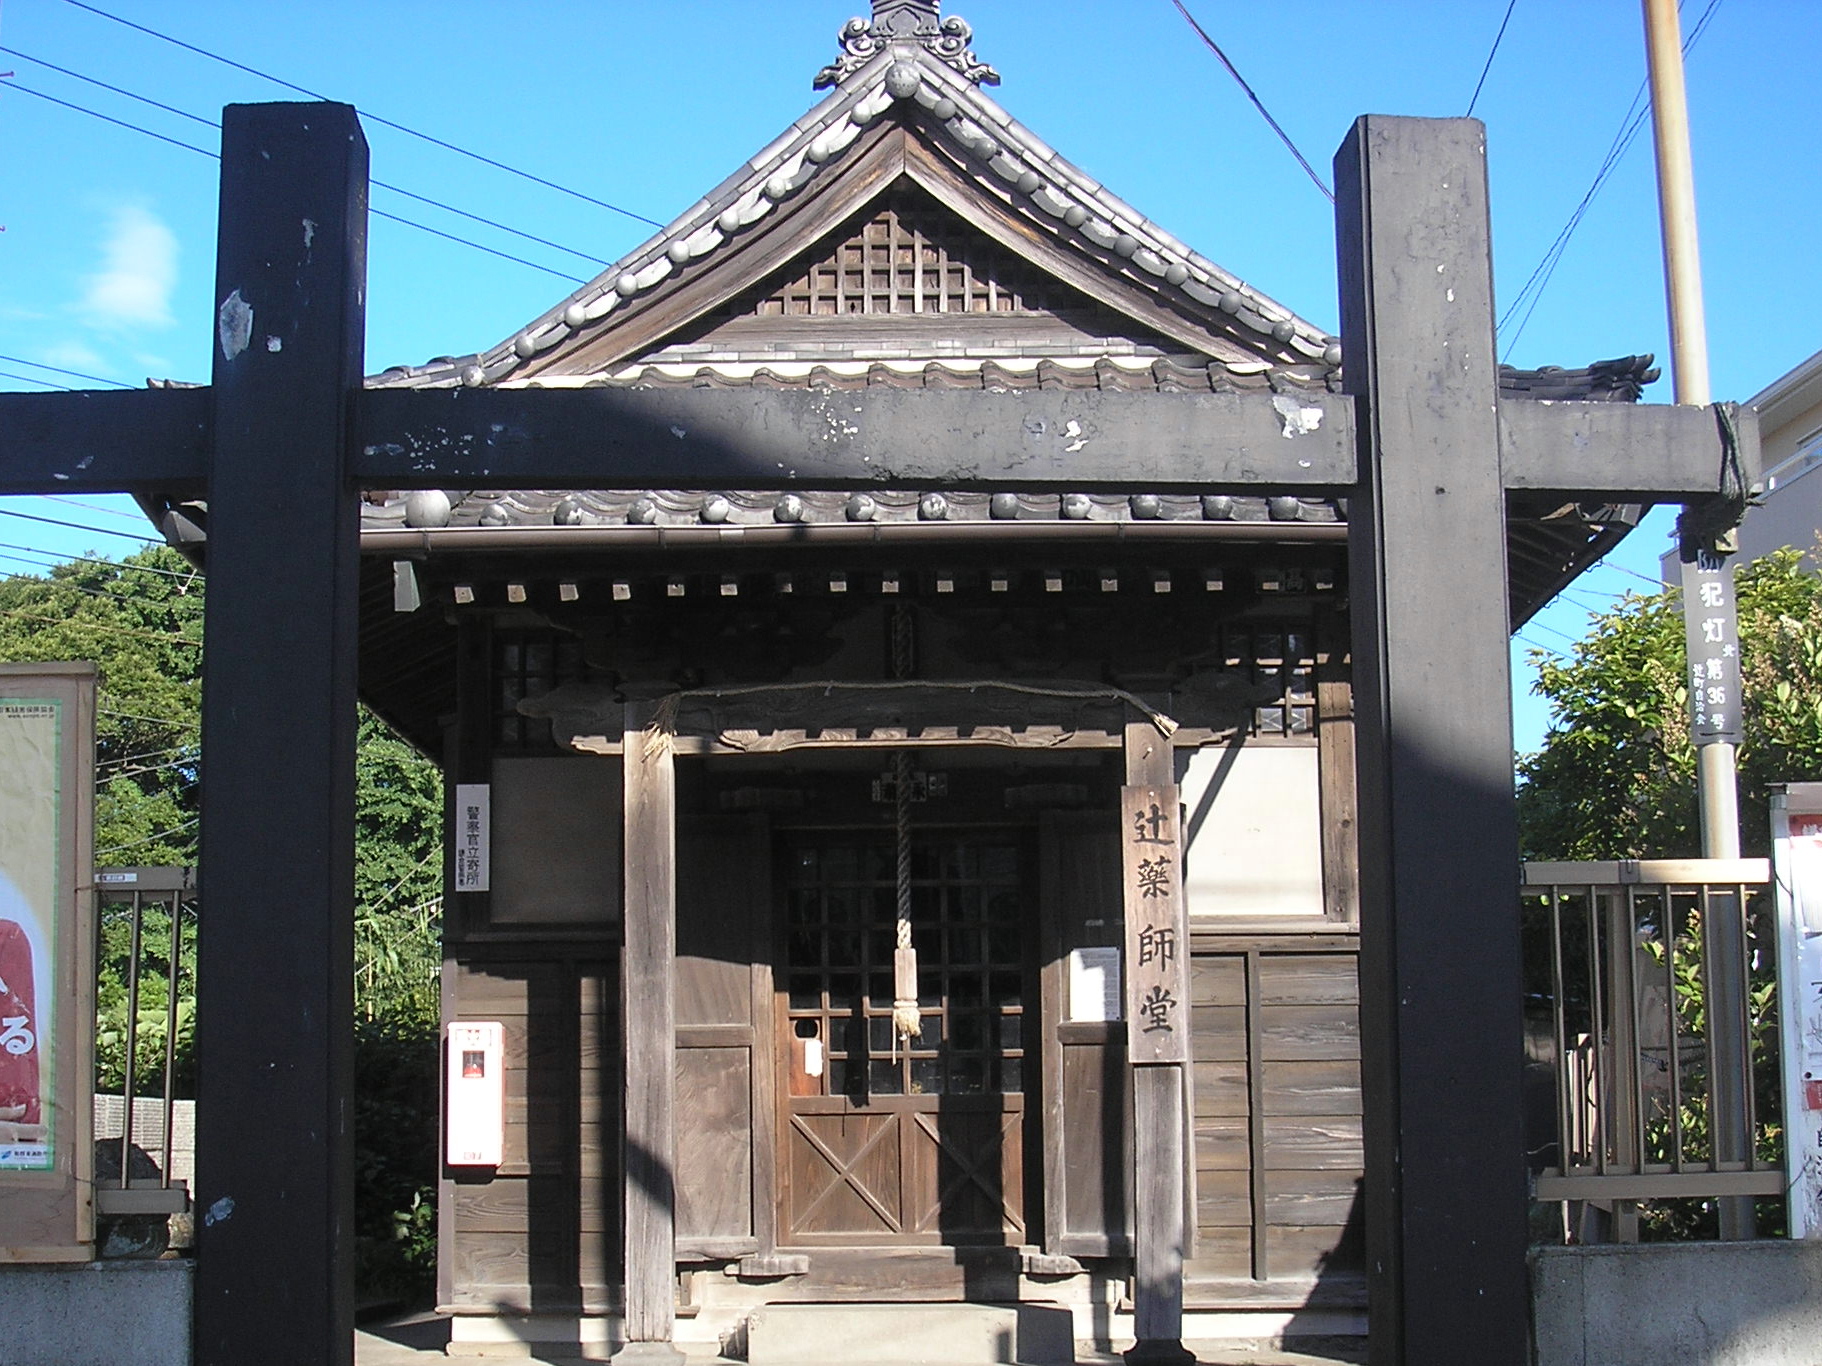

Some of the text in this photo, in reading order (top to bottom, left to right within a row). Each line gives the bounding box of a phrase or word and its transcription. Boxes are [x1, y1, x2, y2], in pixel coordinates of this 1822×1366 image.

[466, 806, 480, 885] 警察官立寄所
